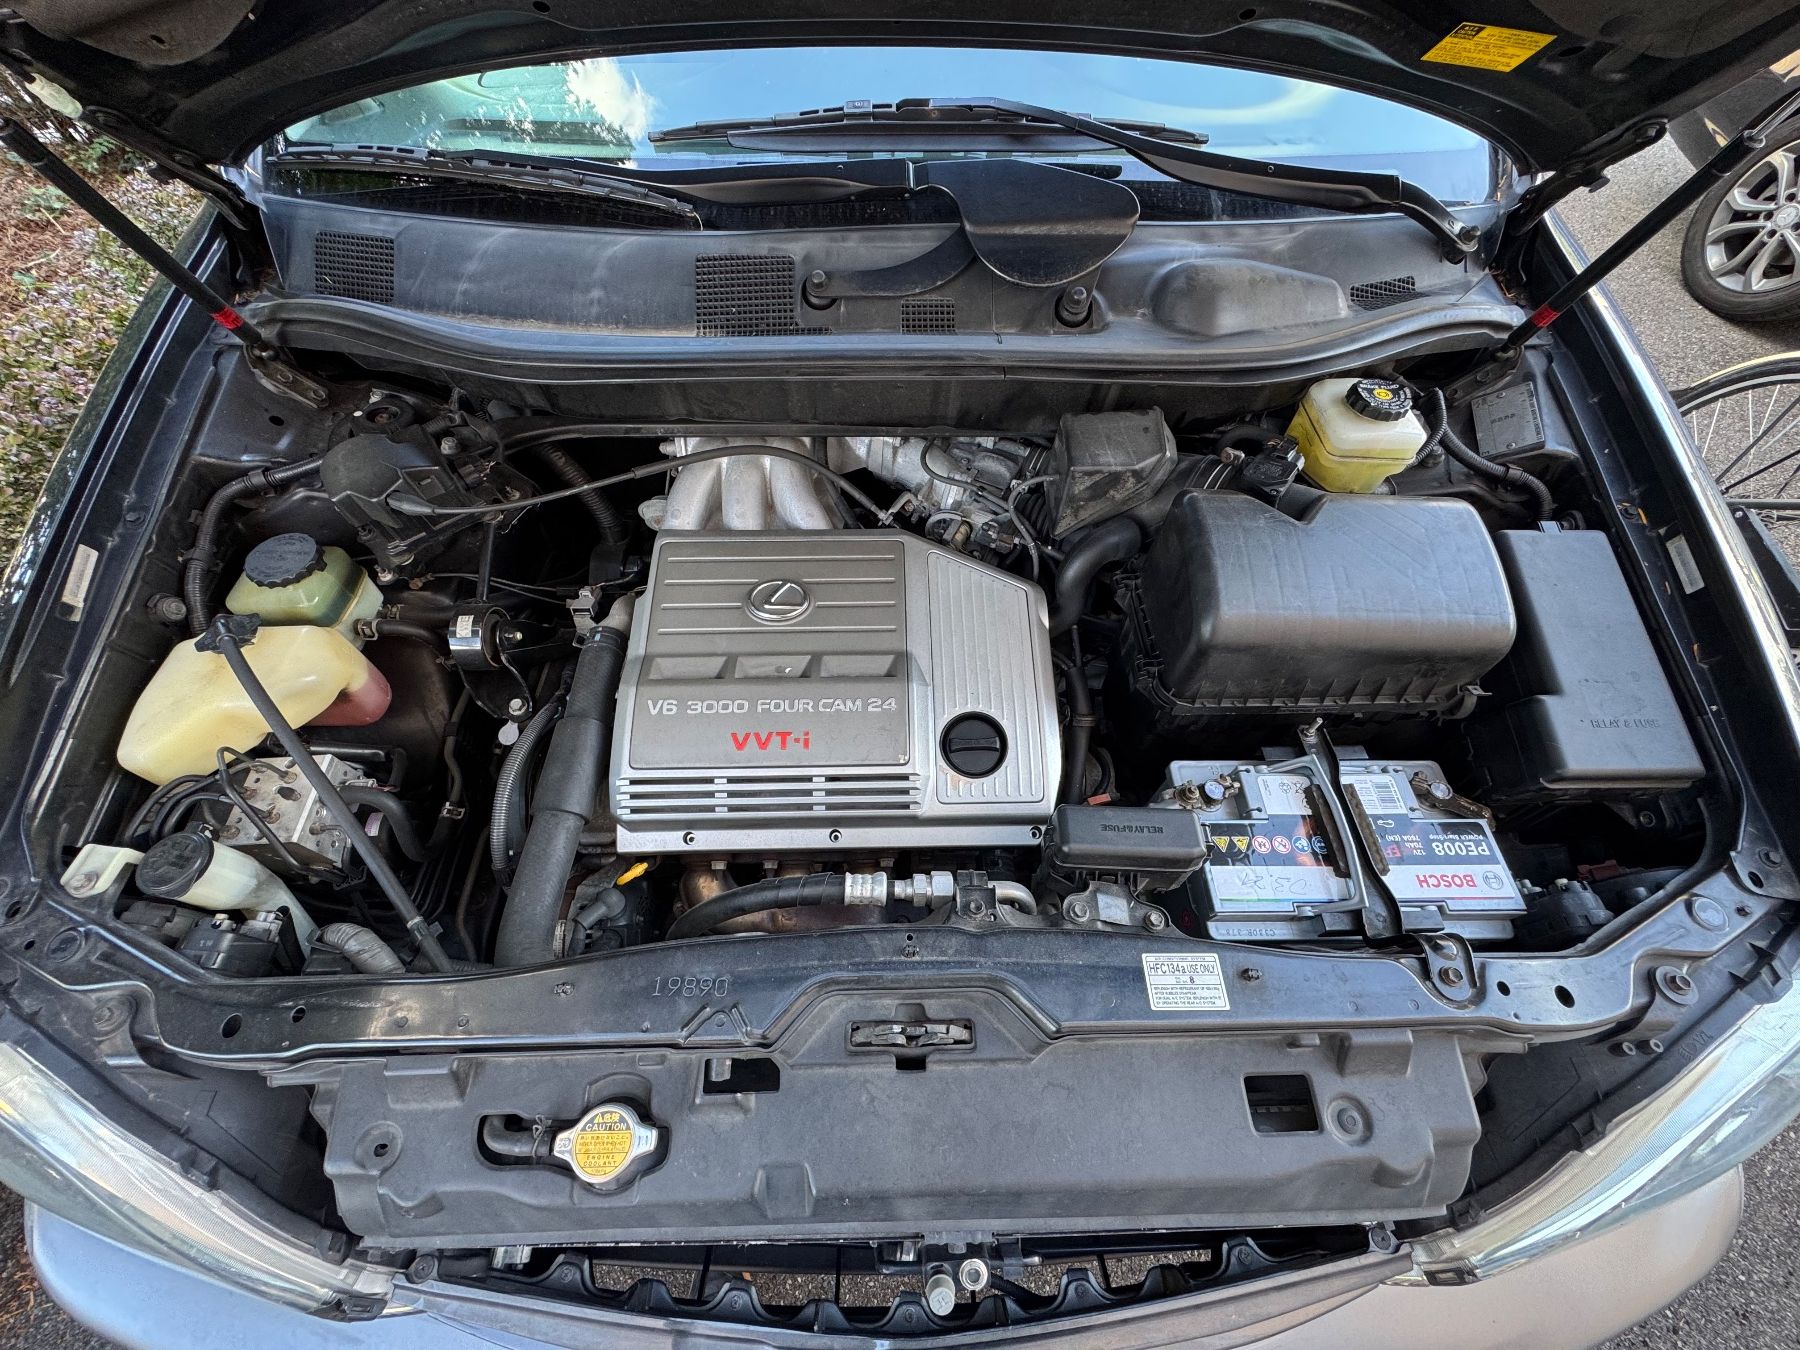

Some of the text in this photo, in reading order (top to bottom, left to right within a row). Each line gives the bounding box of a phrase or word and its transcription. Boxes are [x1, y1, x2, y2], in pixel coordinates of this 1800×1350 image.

[647, 697, 897, 715] V6 3000 FOUR CAM 24
[1431, 841, 1491, 856] PE008
[1415, 874, 1477, 888] BOSCH
[1186, 963, 1200, 974] USE
[652, 976, 729, 997] 19890
[585, 1122, 627, 1131] CAUTION
